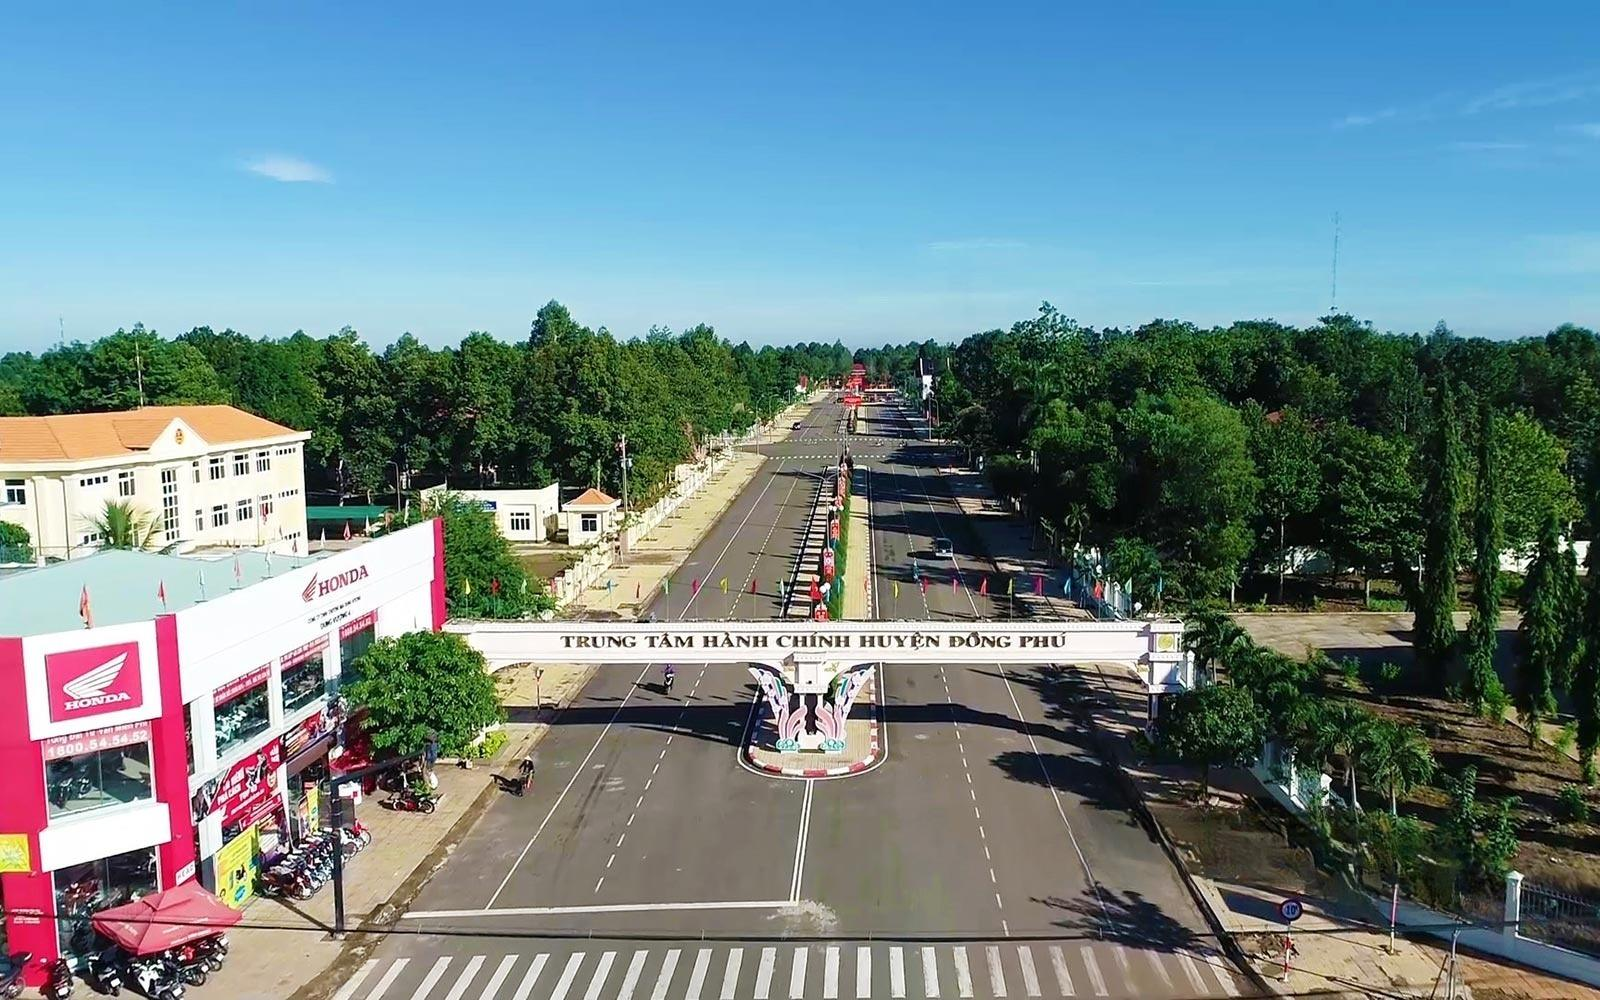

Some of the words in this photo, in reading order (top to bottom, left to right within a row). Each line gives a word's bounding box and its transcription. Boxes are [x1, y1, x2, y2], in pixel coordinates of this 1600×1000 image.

[318, 565, 369, 597] HONDA
[560, 634, 637, 648] TRUNG
[644, 632, 695, 648] TÂM
[703, 631, 769, 648] HÀNH
[776, 631, 851, 648] CHÍNH
[859, 631, 940, 651] HUYỆN
[1019, 631, 1066, 648] PHÚ
[64, 692, 131, 711] HONDA
[48, 730, 148, 756] 1800.54.54.52
